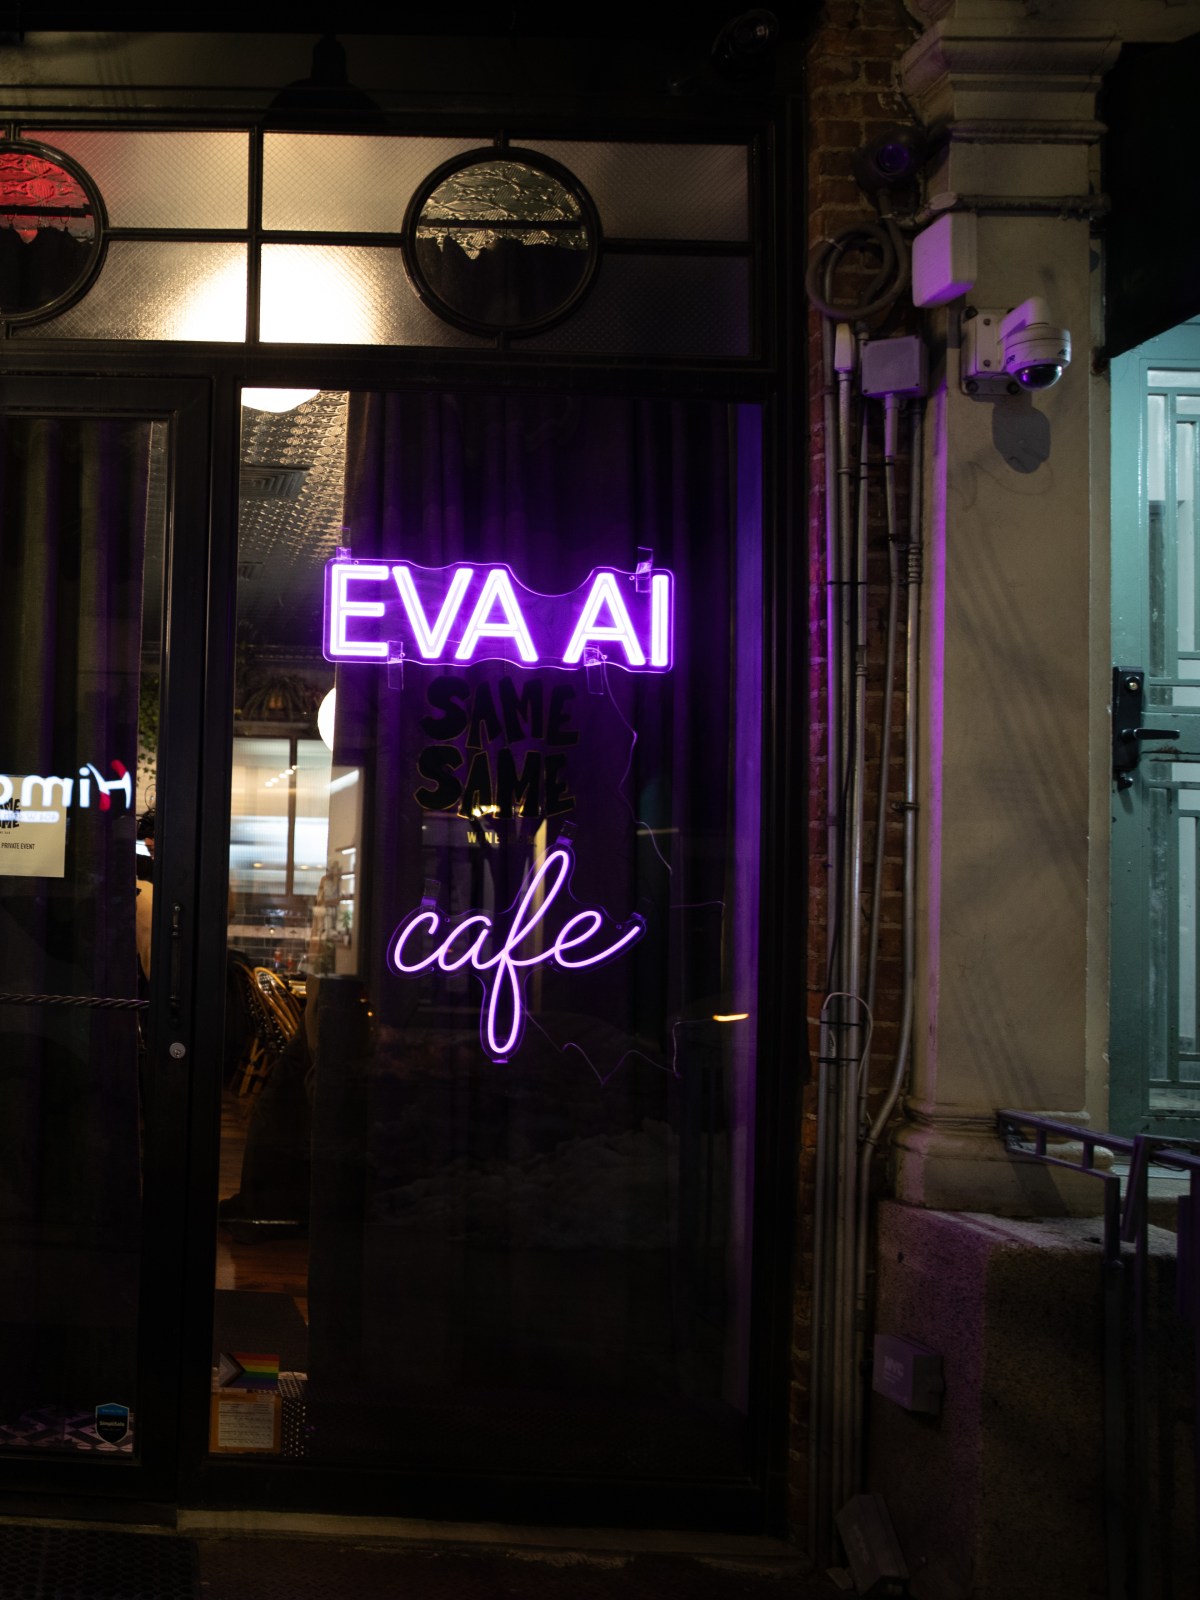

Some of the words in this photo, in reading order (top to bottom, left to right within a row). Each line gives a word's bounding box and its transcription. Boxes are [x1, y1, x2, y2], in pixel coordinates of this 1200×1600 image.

[329, 565, 539, 662] EVA
[562, 571, 669, 667] AI
[418, 677, 580, 748] SAME
[414, 745, 578, 819] SAME
[1, 842, 20, 850] PRIVATE
[466, 831, 501, 844] WNE
[393, 849, 642, 1054] cafe
